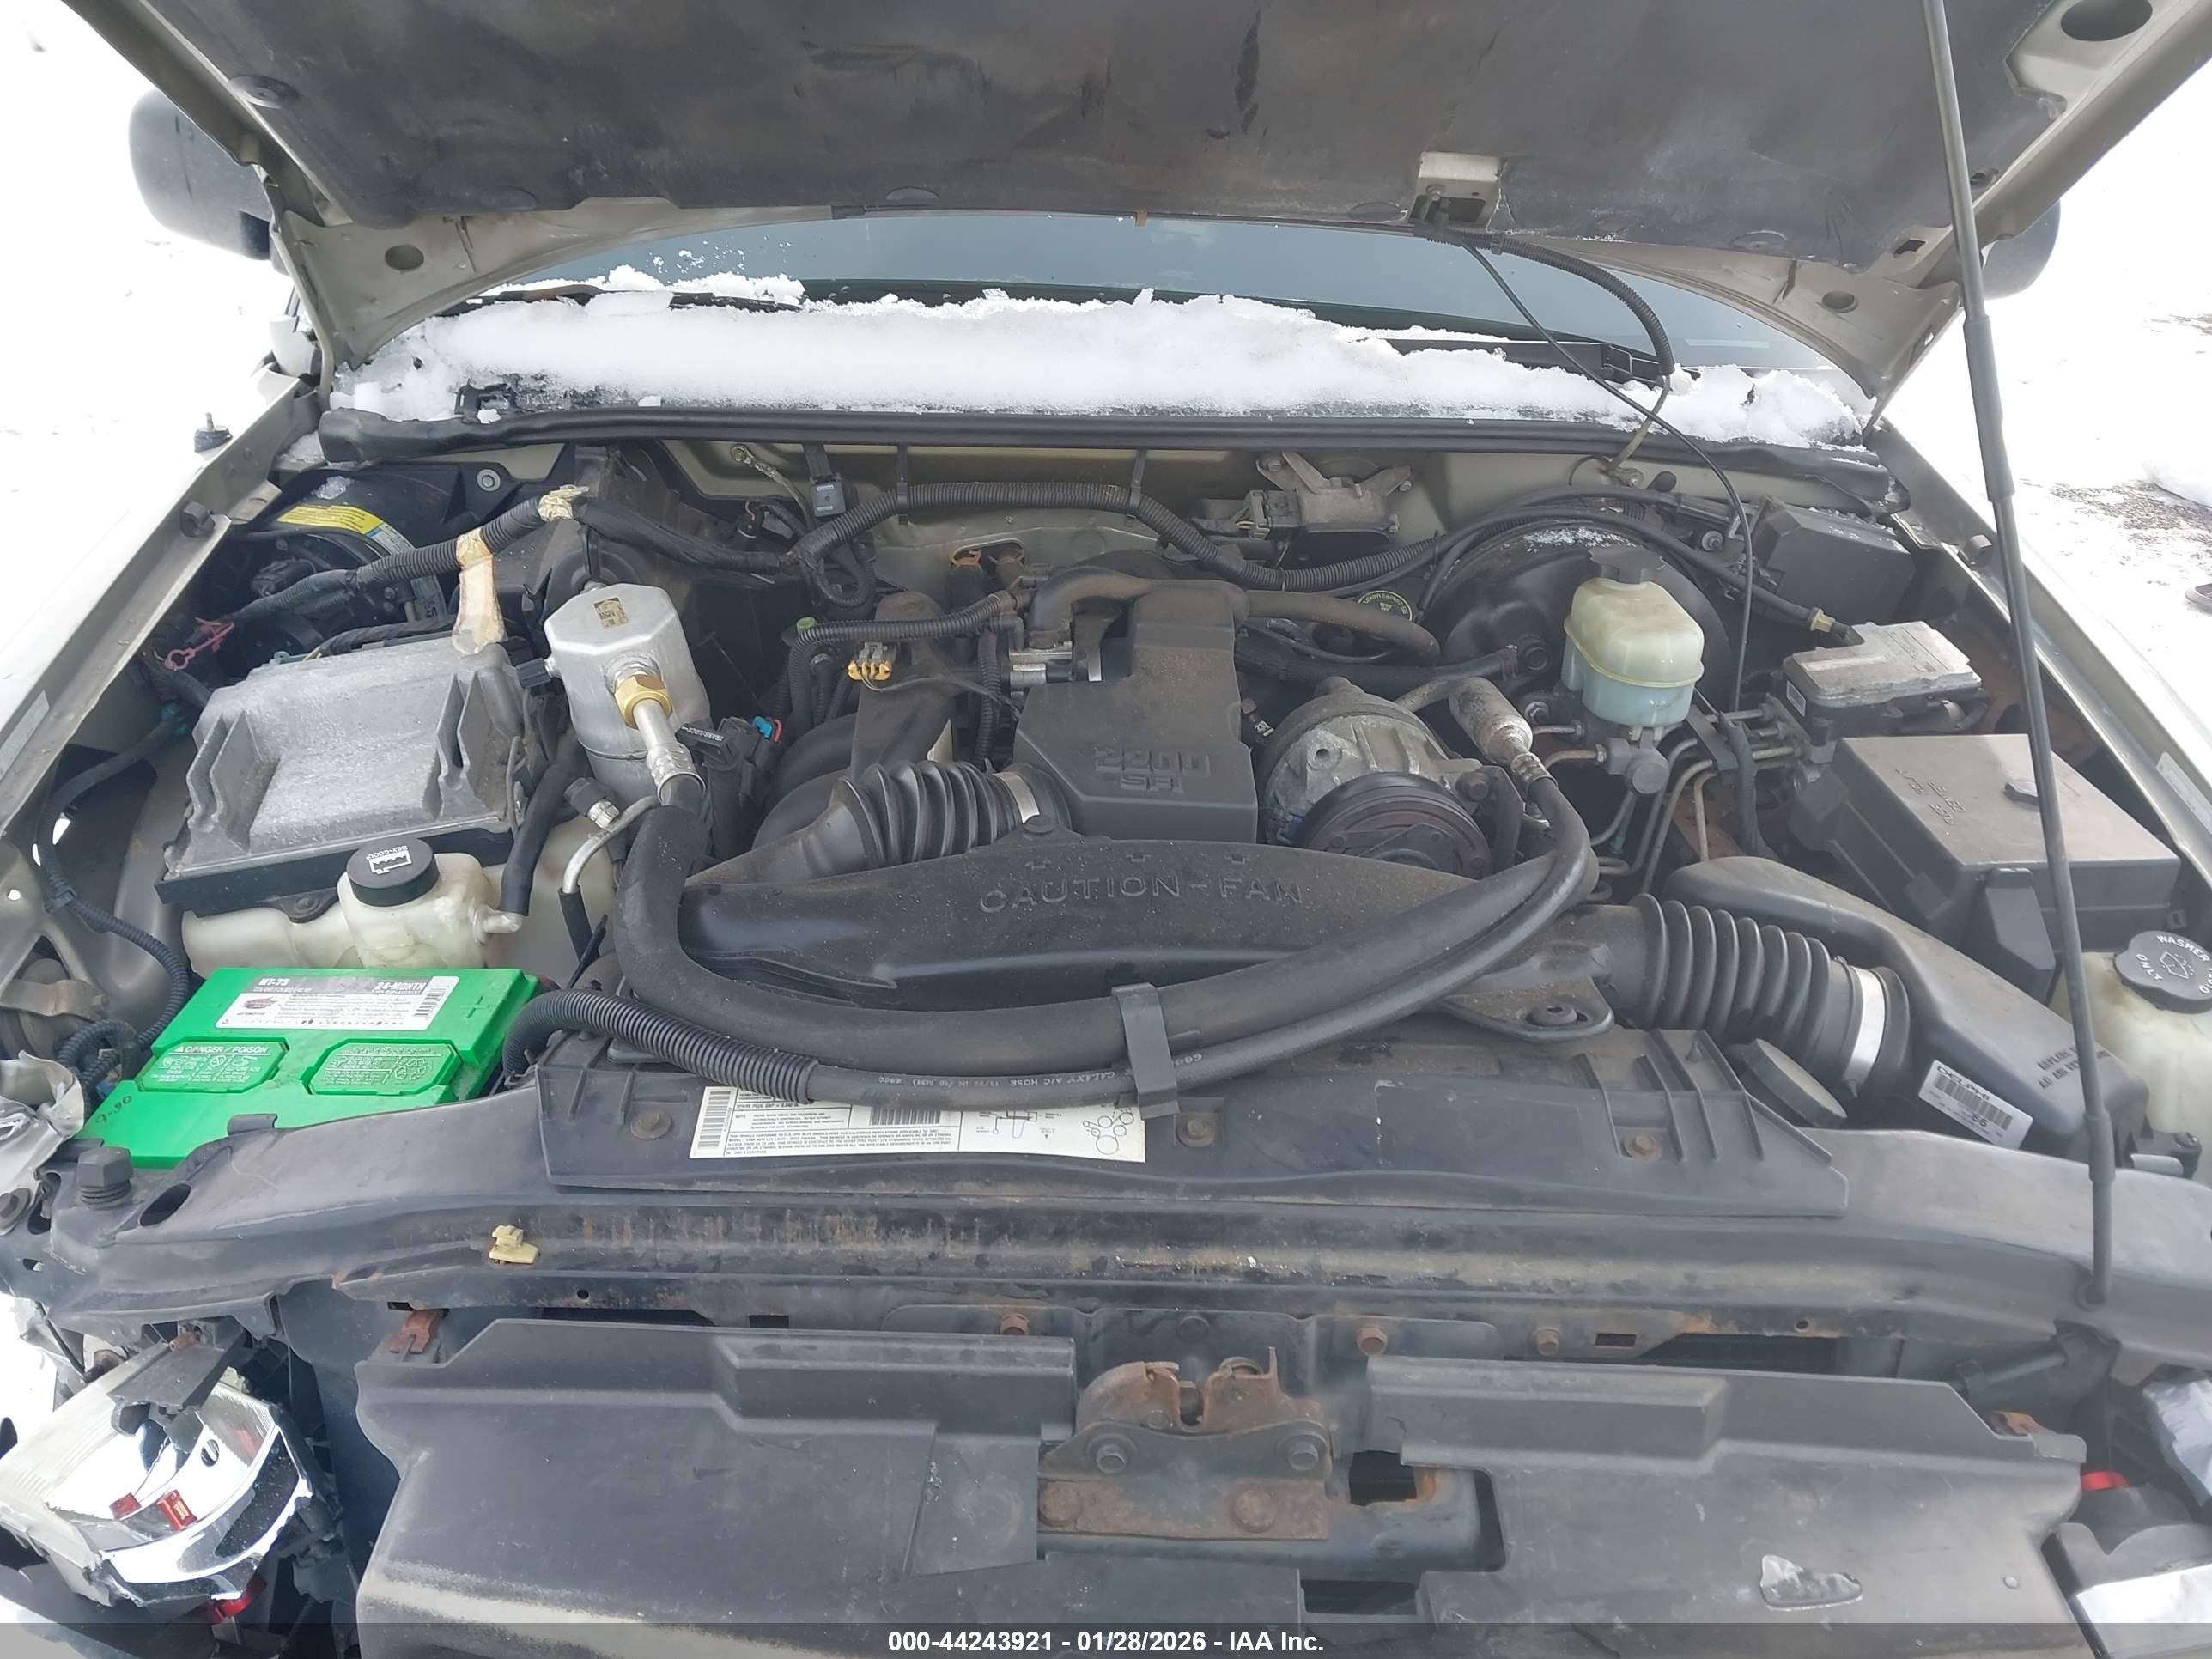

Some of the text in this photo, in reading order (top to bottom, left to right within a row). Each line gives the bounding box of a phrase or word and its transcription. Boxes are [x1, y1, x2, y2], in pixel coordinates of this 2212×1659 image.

[1094, 747, 1211, 777] 2200
[980, 876, 1181, 914] CAUTION
[1218, 877, 1304, 905] FAN
[2156, 934, 2210, 962] WASHER
[2136, 953, 2164, 981] ONLY
[257, 977, 291, 987] MT-75
[373, 981, 427, 991] 24-MONTH
[183, 1045, 222, 1054] DANGER
[232, 1045, 269, 1054] POISON
[1010, 1078, 1038, 1086] HOSE
[1044, 1076, 1063, 1085] A/C
[1066, 1071, 1115, 1084] GALAXY
[1936, 1066, 1990, 1101] DELPHI
